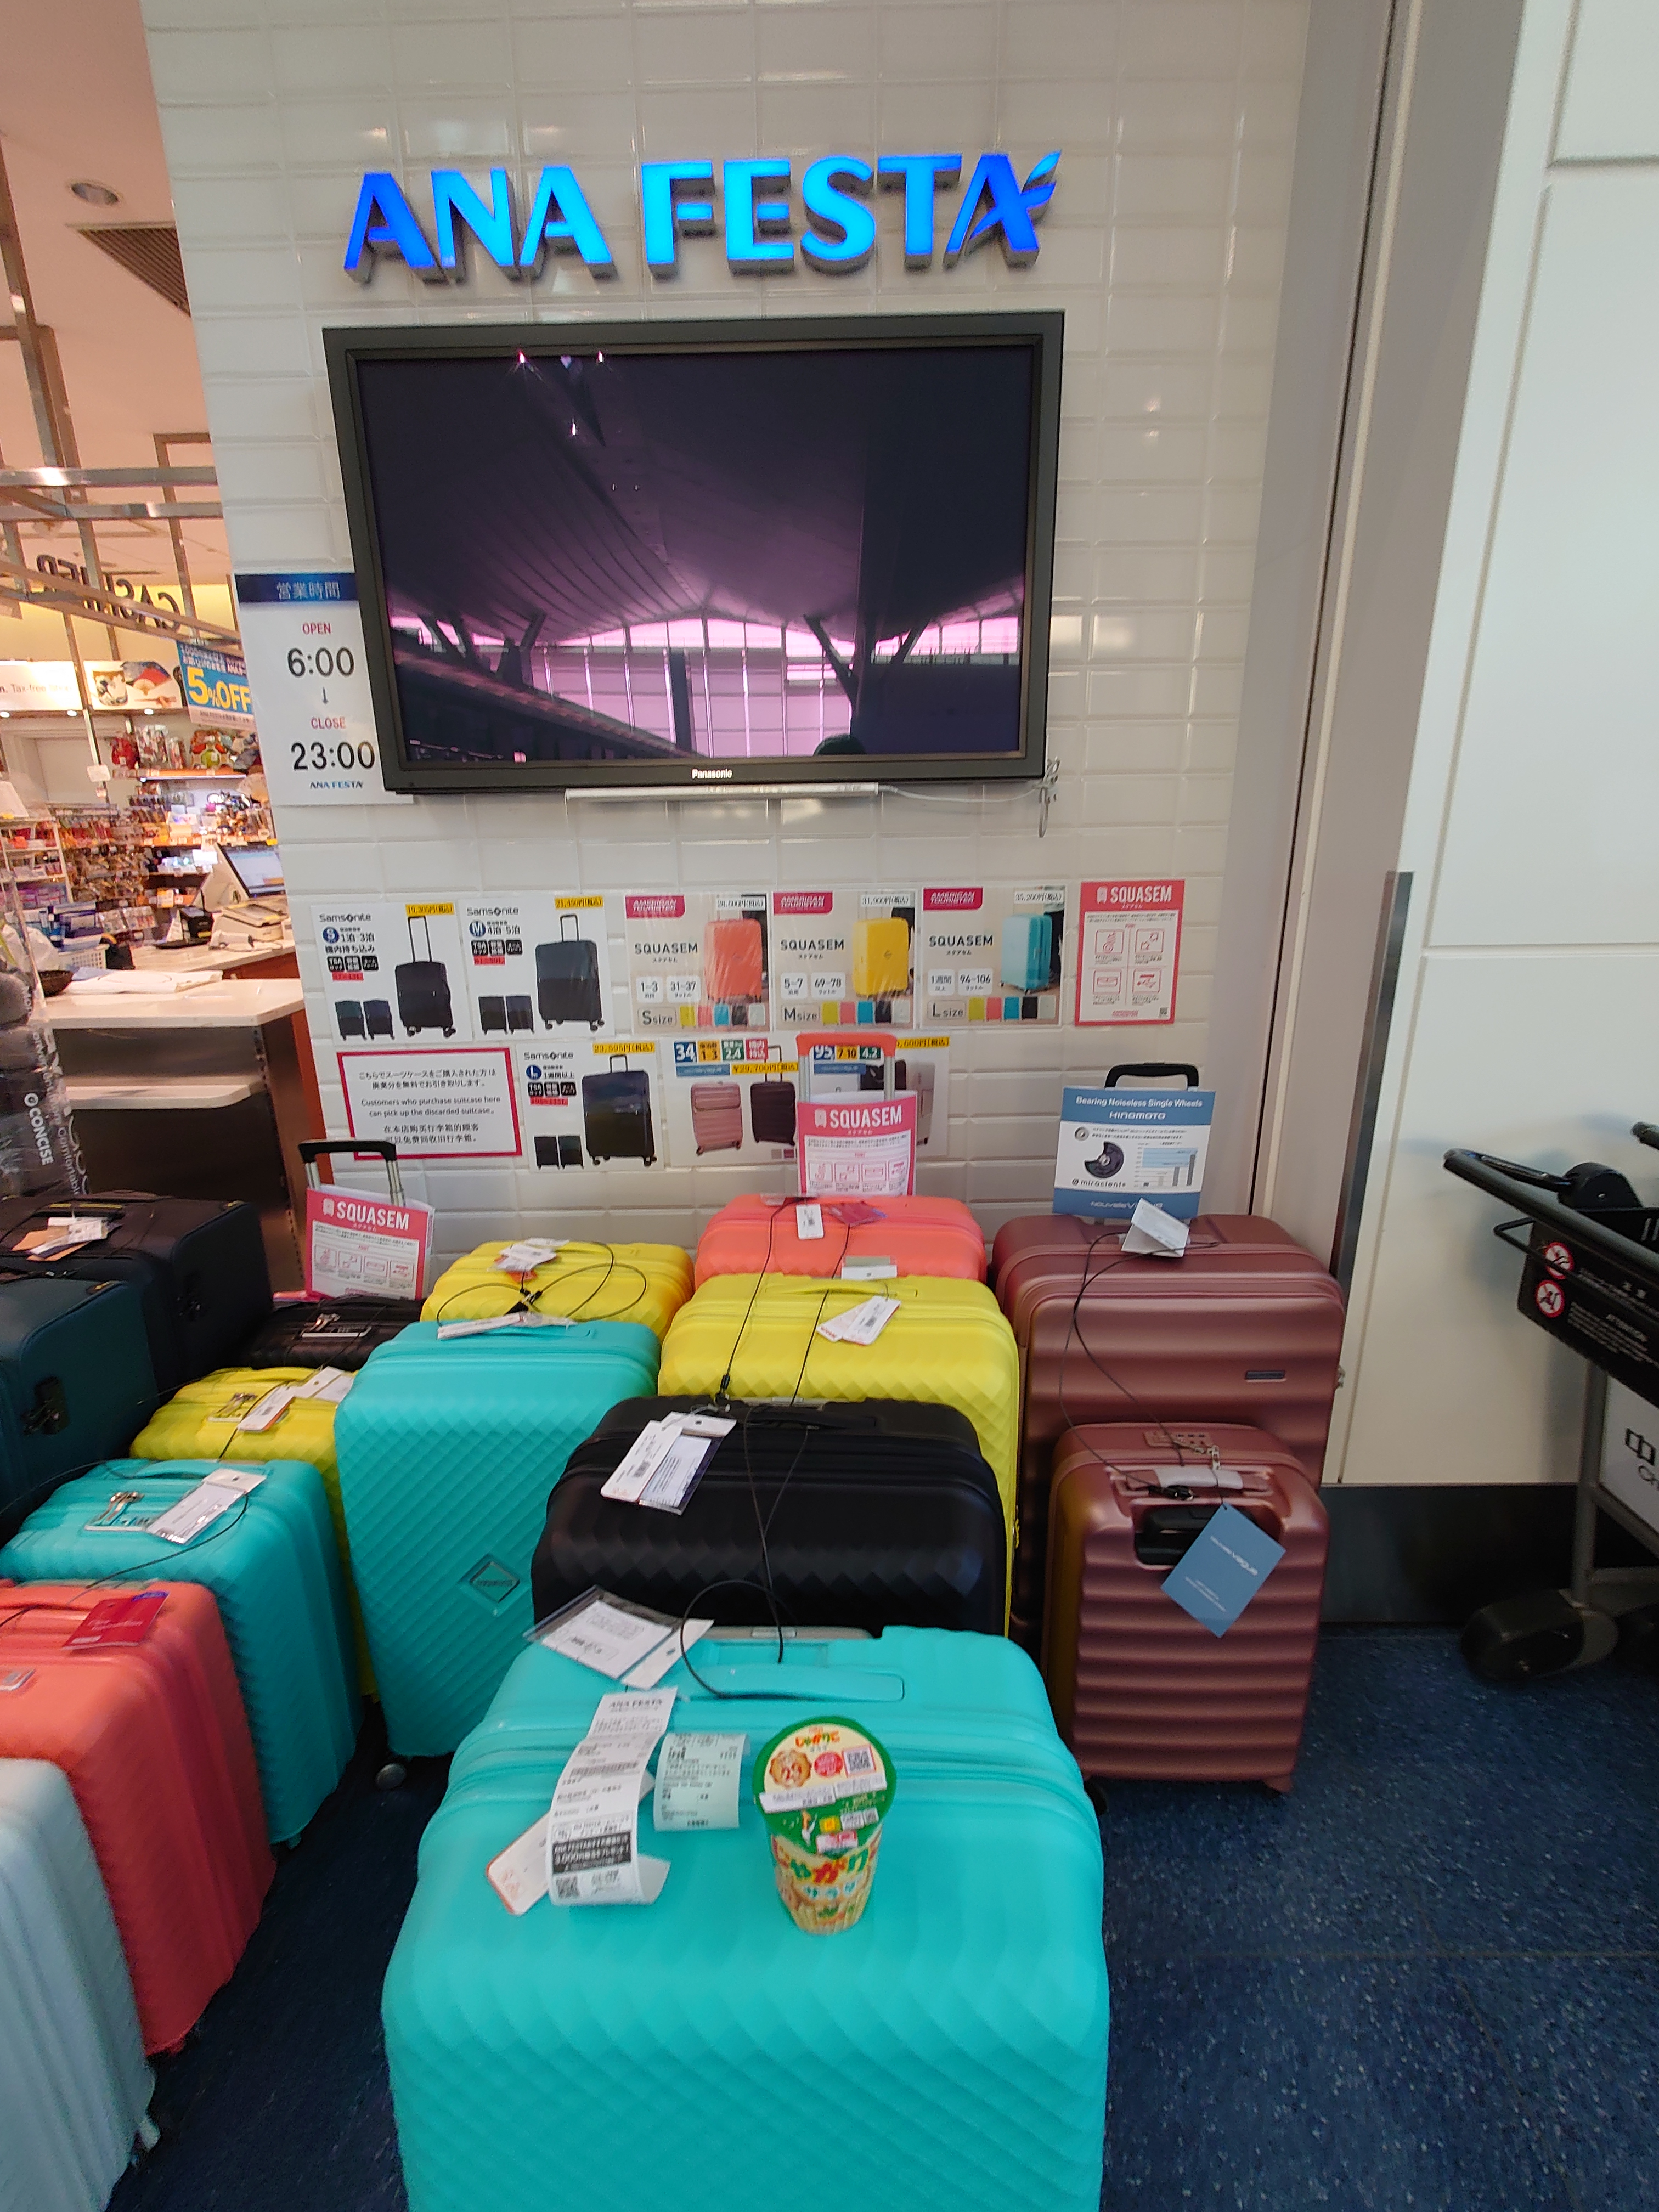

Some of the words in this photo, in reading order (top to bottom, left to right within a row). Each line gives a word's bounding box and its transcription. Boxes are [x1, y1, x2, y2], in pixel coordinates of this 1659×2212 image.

[344, 165, 613, 272] ANA
[641, 151, 1062, 266] FESTA
[276, 582, 340, 600] 営業時間
[302, 622, 331, 635] OPEN
[287, 647, 354, 677] 6:00
[311, 717, 346, 730] CLOSE
[291, 741, 375, 770] 23:00
[692, 768, 732, 779] Panasonic
[1110, 885, 1173, 904] SQUASEM
[319, 913, 371, 923] Samsonite
[467, 907, 519, 917] Samsonite
[781, 939, 844, 951] SQUASEM
[929, 935, 994, 947] SQUASEM
[635, 943, 698, 955] SQUASEM
[524, 1051, 574, 1060] Samsonite
[725, 1048, 742, 1060] 2.4
[862, 1046, 878, 1058] 4.2
[361, 1098, 400, 1107] Customers
[419, 1097, 452, 1107] purchase
[1076, 1096, 1107, 1107] Bearing
[1108, 1097, 1147, 1108] Noiseless
[1148, 1099, 1173, 1108] Single
[1174, 1099, 1203, 1108] Wheels
[383, 1109, 397, 1118] pick
[425, 1107, 459, 1116] discarded
[830, 1104, 902, 1129] SQUASEM
[1109, 1111, 1166, 1120] HINOMOTO
[29, 1107, 54, 1166] CONCISE
[336, 1201, 410, 1231] SQUASEM
